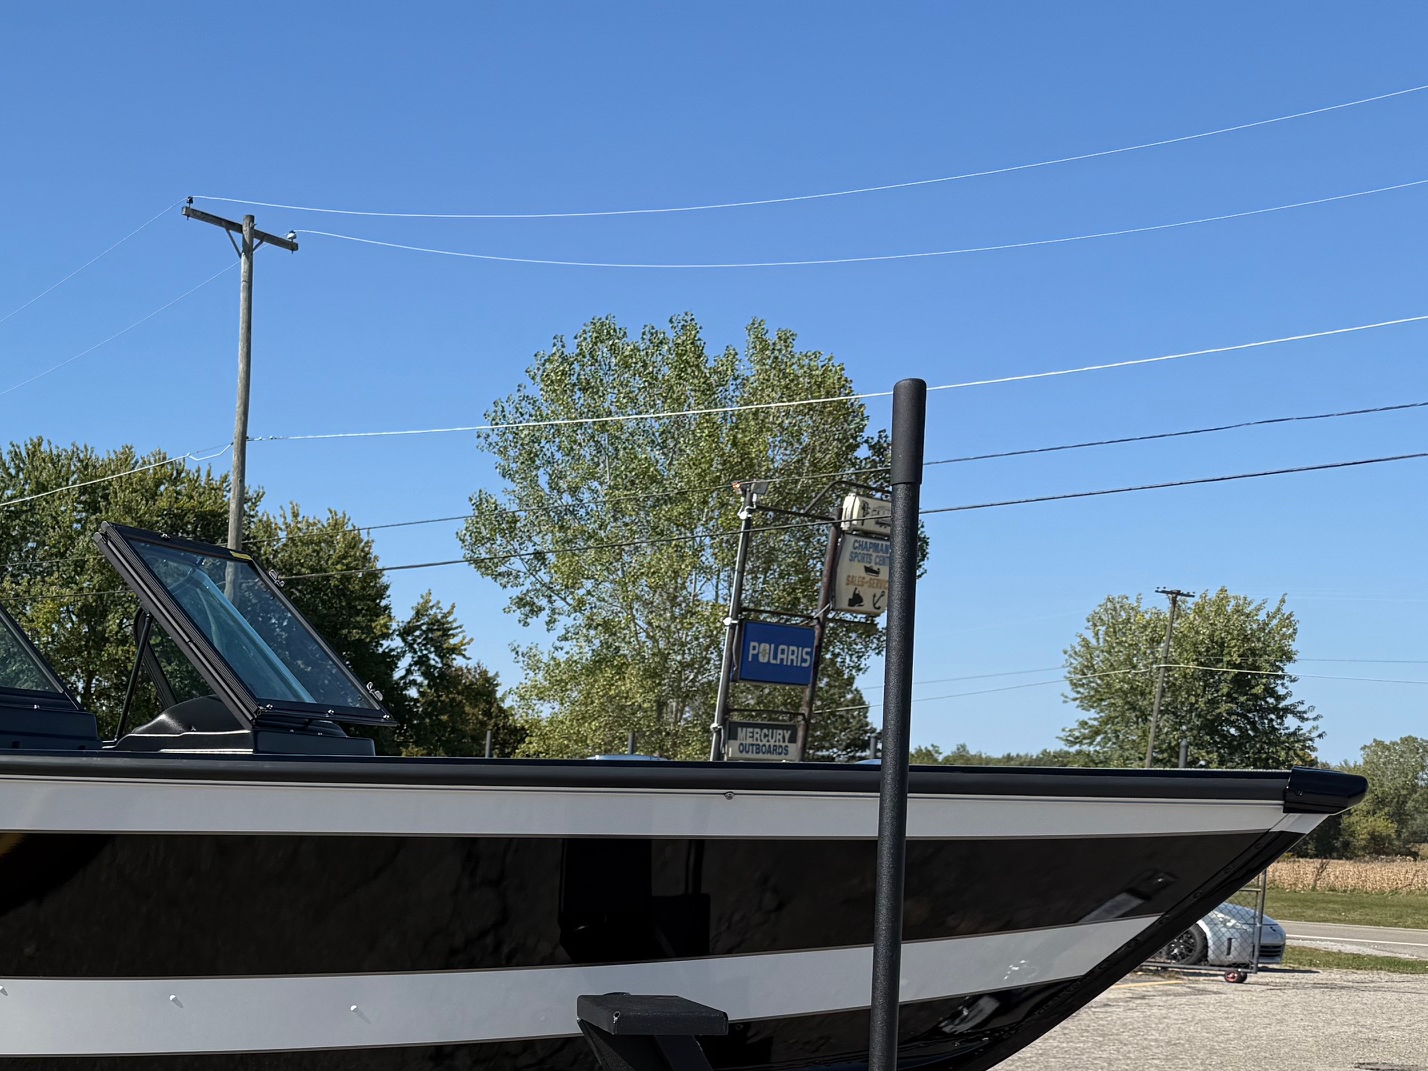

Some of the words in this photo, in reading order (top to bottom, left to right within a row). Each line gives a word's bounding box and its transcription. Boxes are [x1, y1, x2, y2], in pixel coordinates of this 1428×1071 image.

[849, 551, 873, 564] SPORTS
[874, 555, 890, 566] CENT
[845, 574, 889, 590] SALES-SERVIC
[748, 641, 812, 668] POLARIS
[737, 727, 792, 744] MERCURY
[738, 742, 789, 756] OUTBOARDS
